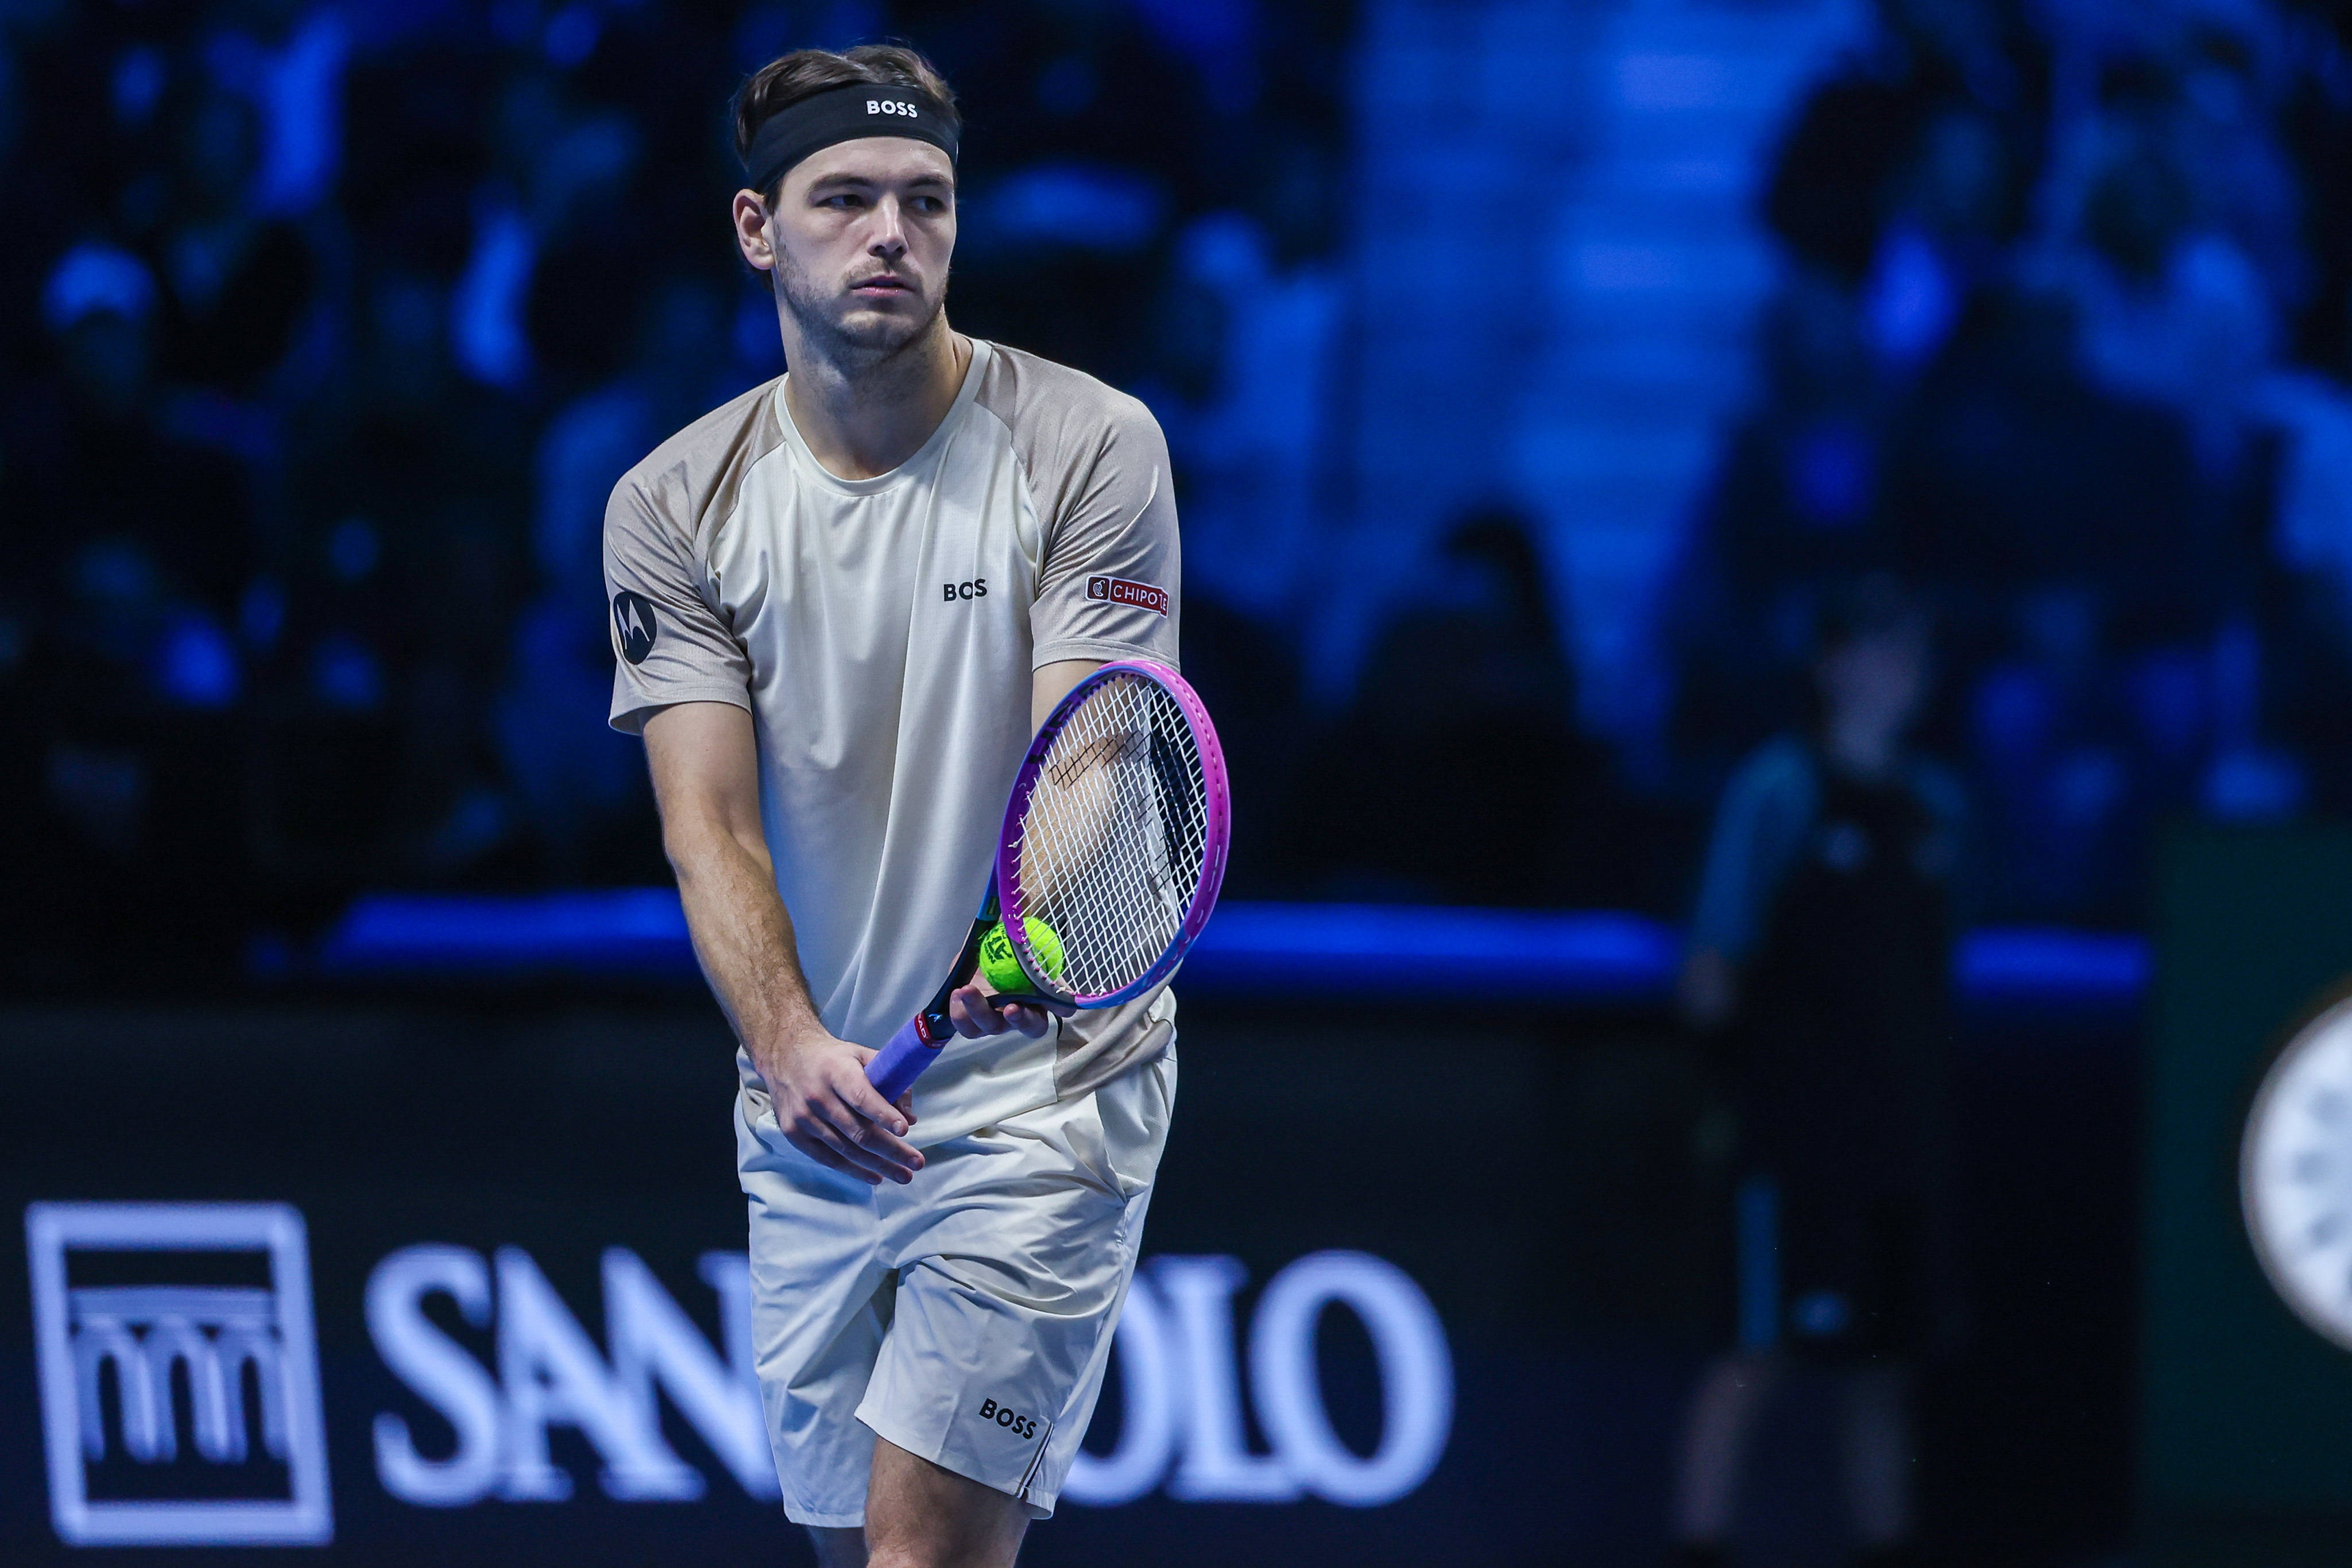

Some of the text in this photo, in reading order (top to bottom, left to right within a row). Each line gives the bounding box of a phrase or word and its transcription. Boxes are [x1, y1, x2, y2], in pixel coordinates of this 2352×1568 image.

[866, 100, 918, 118] BOSS
[943, 578, 988, 602] BOS
[1113, 584, 1167, 611] CHIPOE
[978, 1397, 1037, 1439] BOSS
